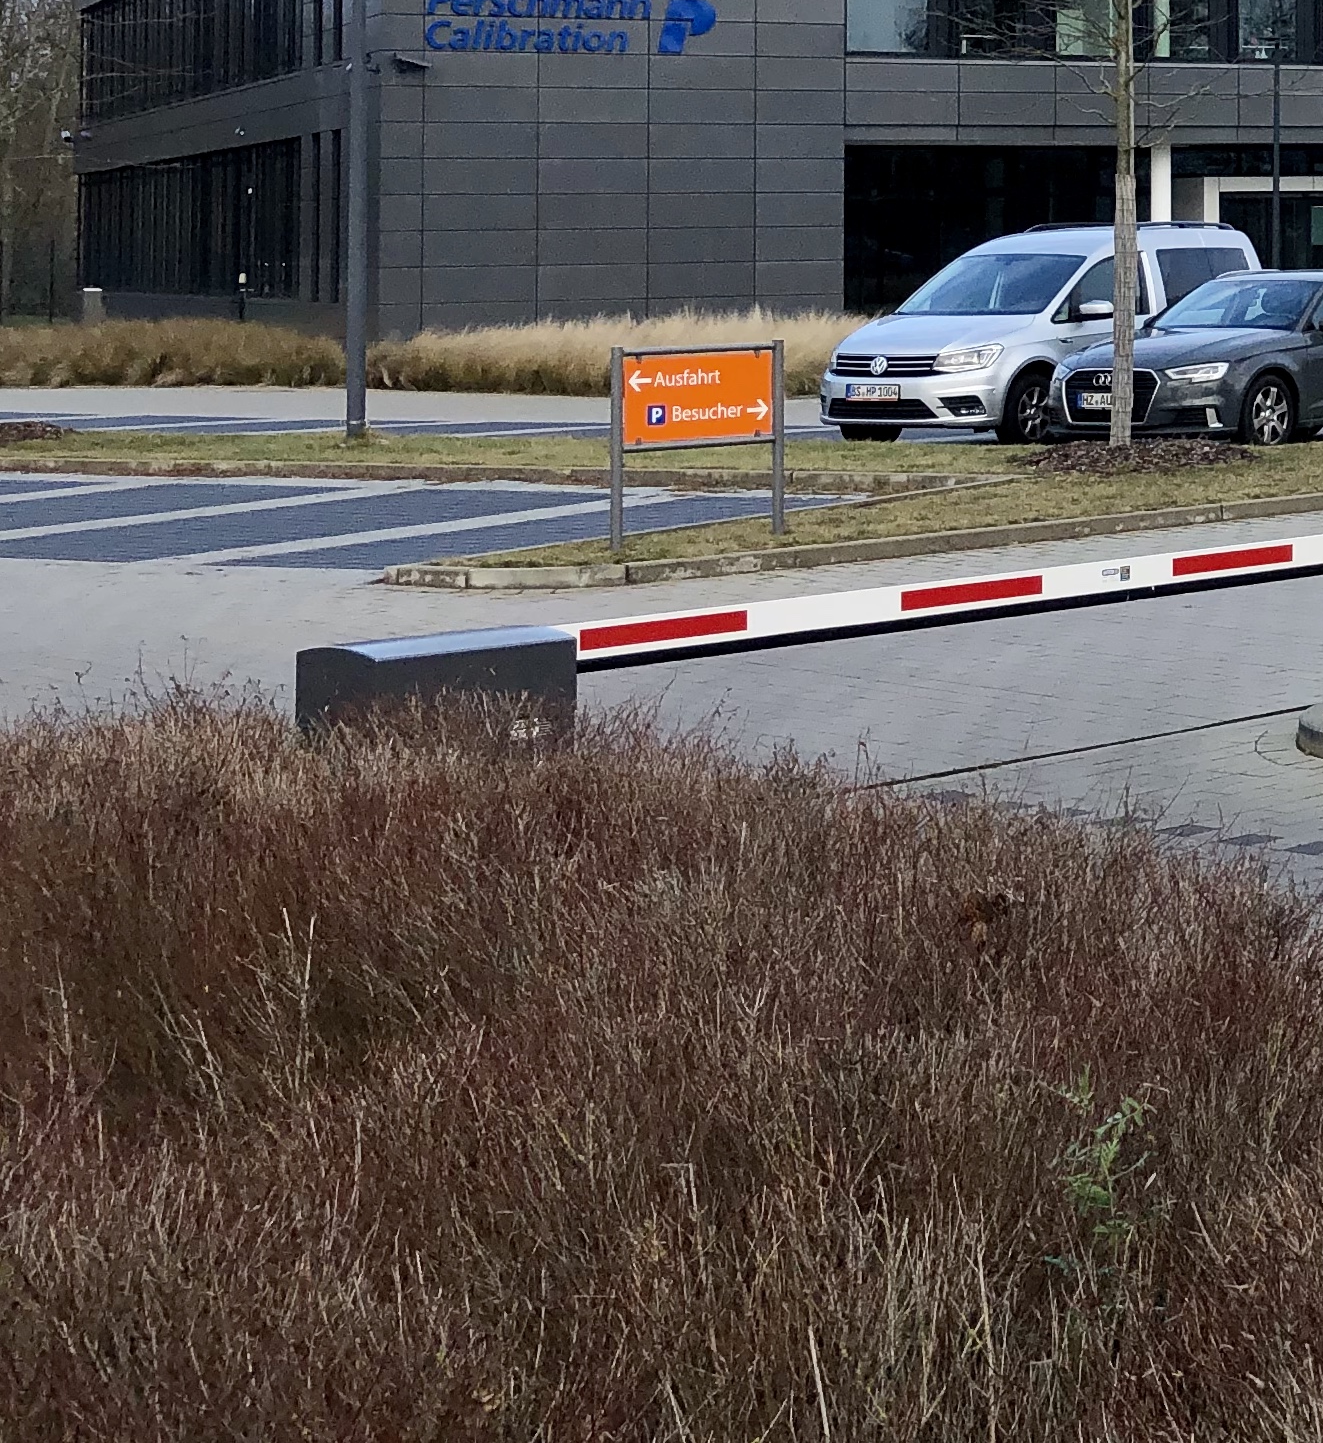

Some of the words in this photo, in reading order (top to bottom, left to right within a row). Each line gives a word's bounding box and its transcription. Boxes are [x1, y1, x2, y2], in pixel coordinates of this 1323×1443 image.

[425, 19, 628, 52] Calibration
[654, 369, 721, 387] Ausfahrt
[672, 403, 743, 421] Besucher
